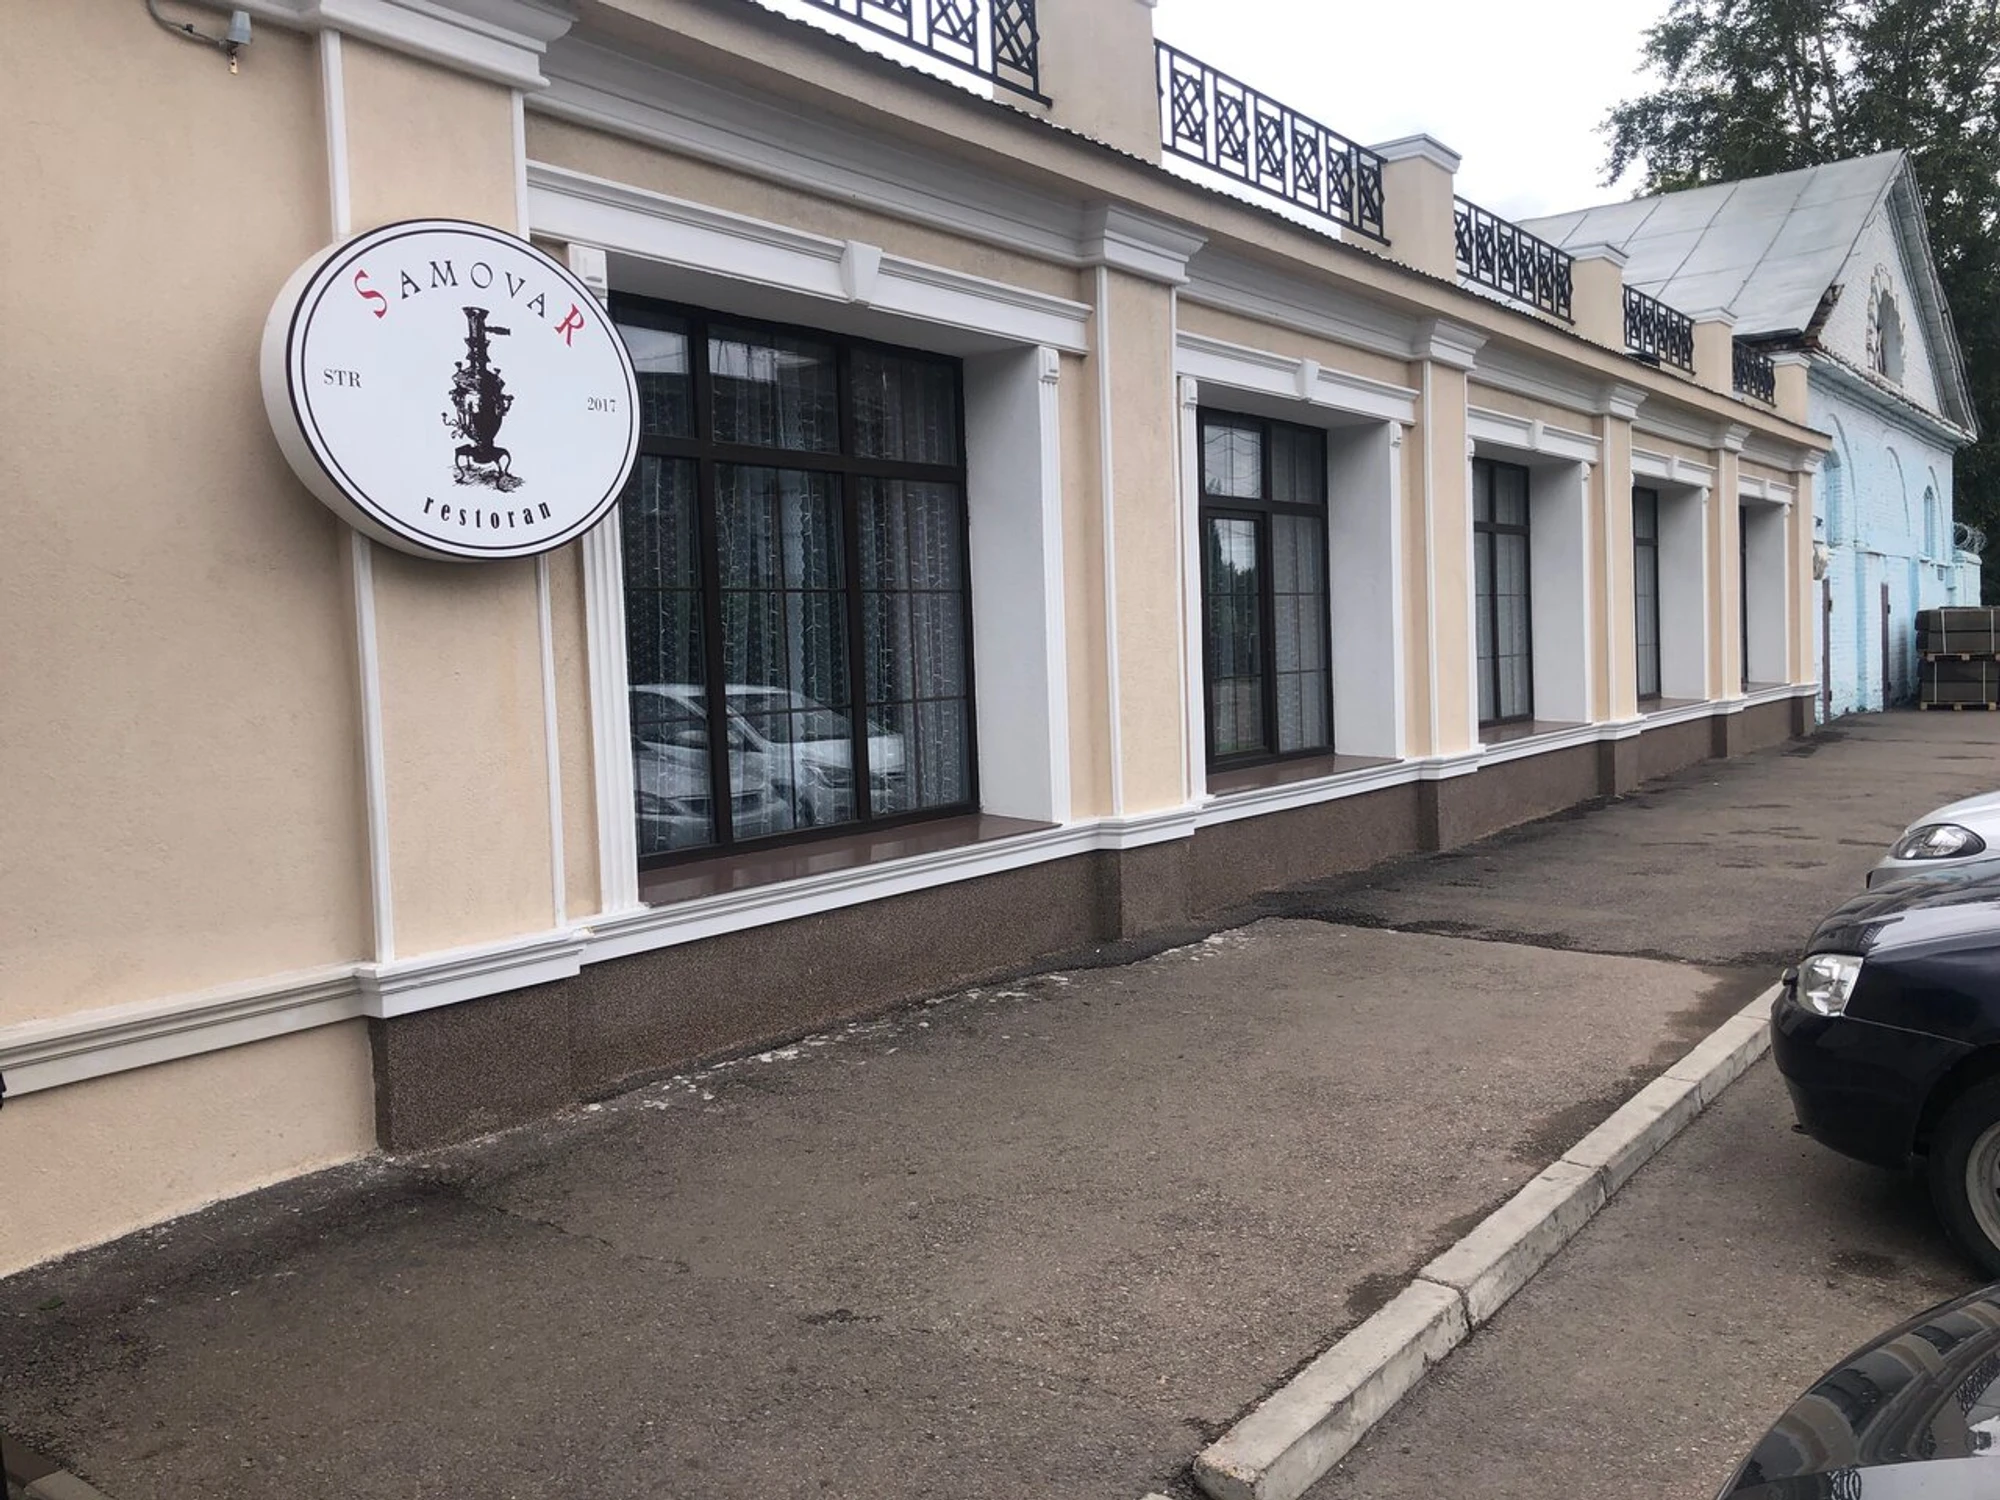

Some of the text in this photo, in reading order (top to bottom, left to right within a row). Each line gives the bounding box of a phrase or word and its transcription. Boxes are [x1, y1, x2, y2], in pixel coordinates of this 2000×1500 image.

[354, 260, 585, 347] SAMOVAR
[323, 369, 362, 388] STR
[587, 397, 616, 413] 2017
[423, 496, 552, 530] restoran
